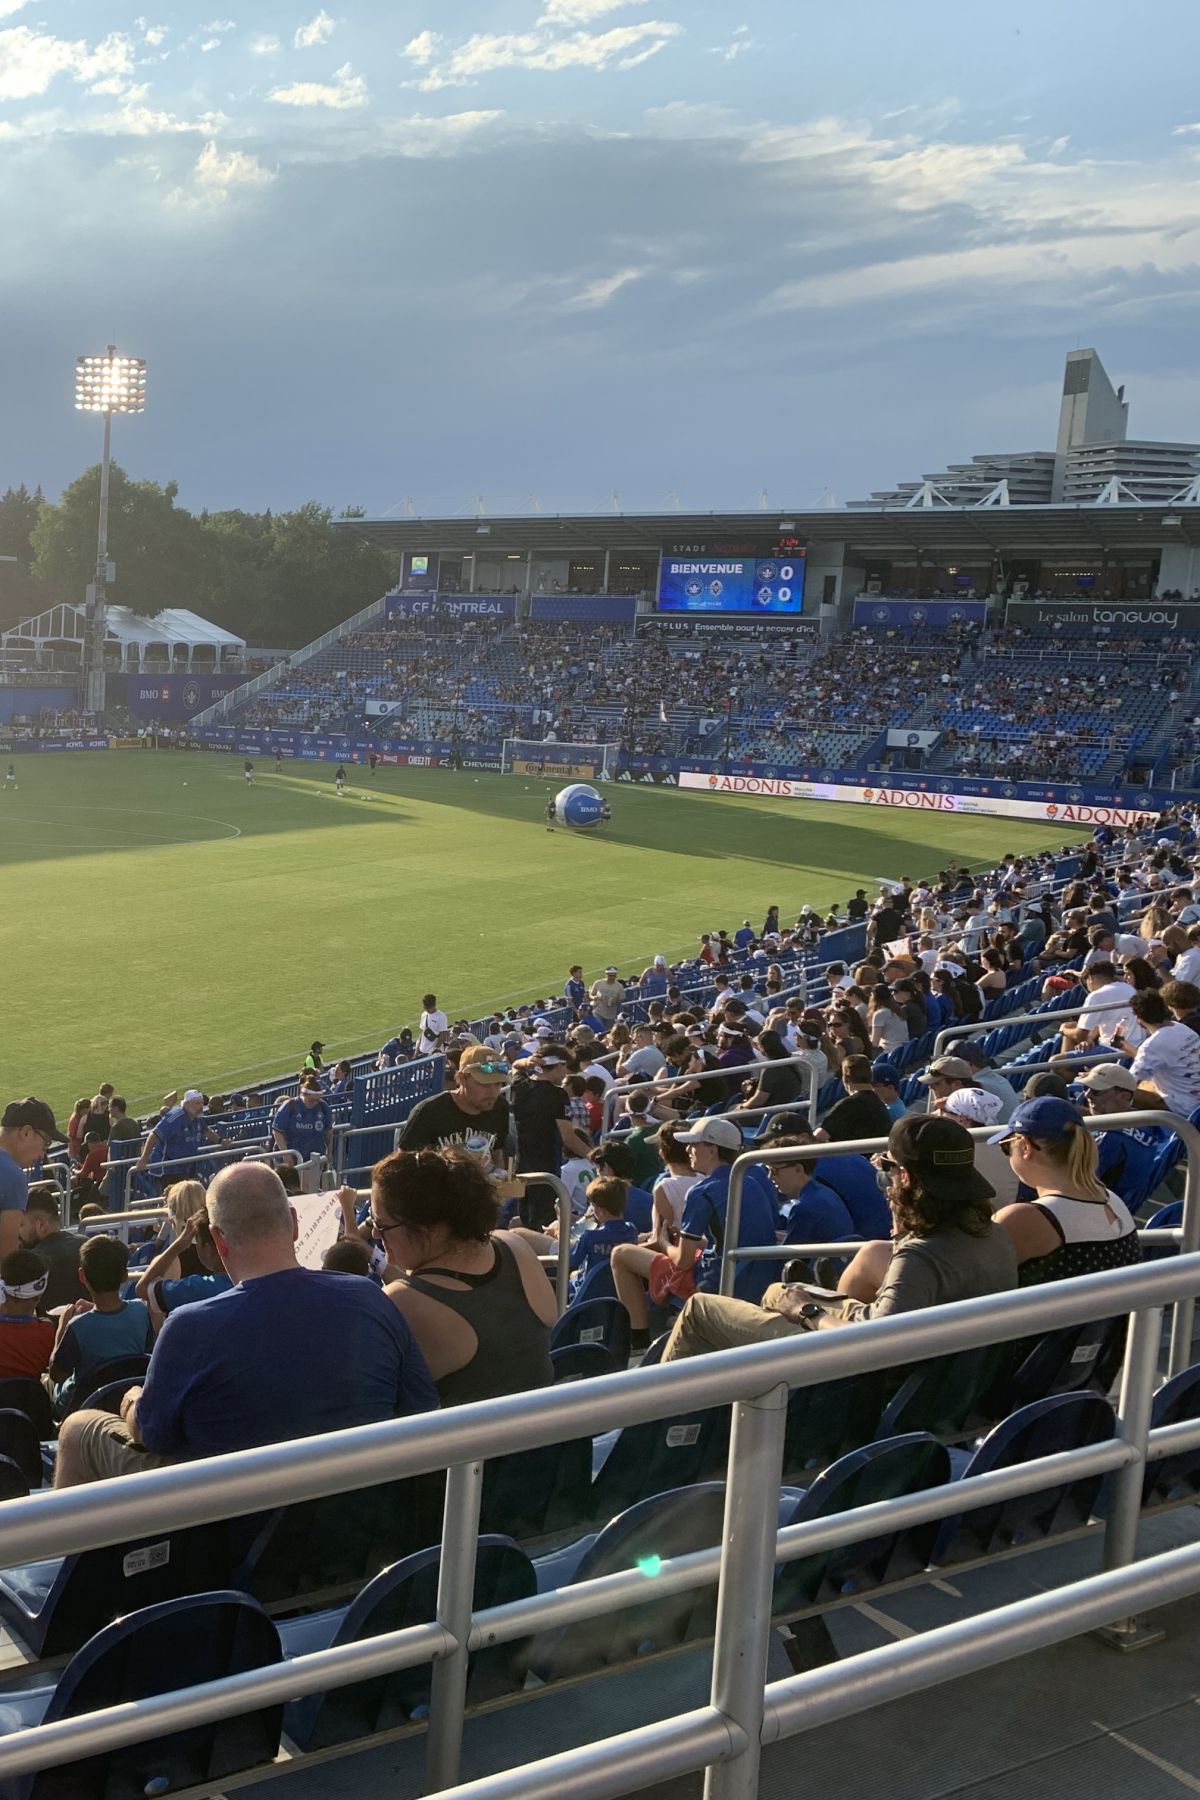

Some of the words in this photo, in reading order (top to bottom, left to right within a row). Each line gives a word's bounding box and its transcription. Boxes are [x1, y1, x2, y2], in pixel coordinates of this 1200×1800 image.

[670, 563, 743, 574] BIENVENUE
[780, 566, 794, 581] 0
[777, 586, 792, 602] 0
[412, 602, 430, 613] CF
[432, 600, 504, 615] ONTRÉAL
[1038, 611, 1053, 622] Le
[1056, 611, 1089, 622] salon
[1093, 607, 1179, 629] tanguay
[695, 623, 734, 631] Ensemble
[140, 689, 159, 699] BMO
[462, 760, 511, 769] CHEVROLET
[720, 776, 792, 795] ADONIS
[876, 789, 955, 809] ADONIS
[296, 1122, 313, 1130] BMO
